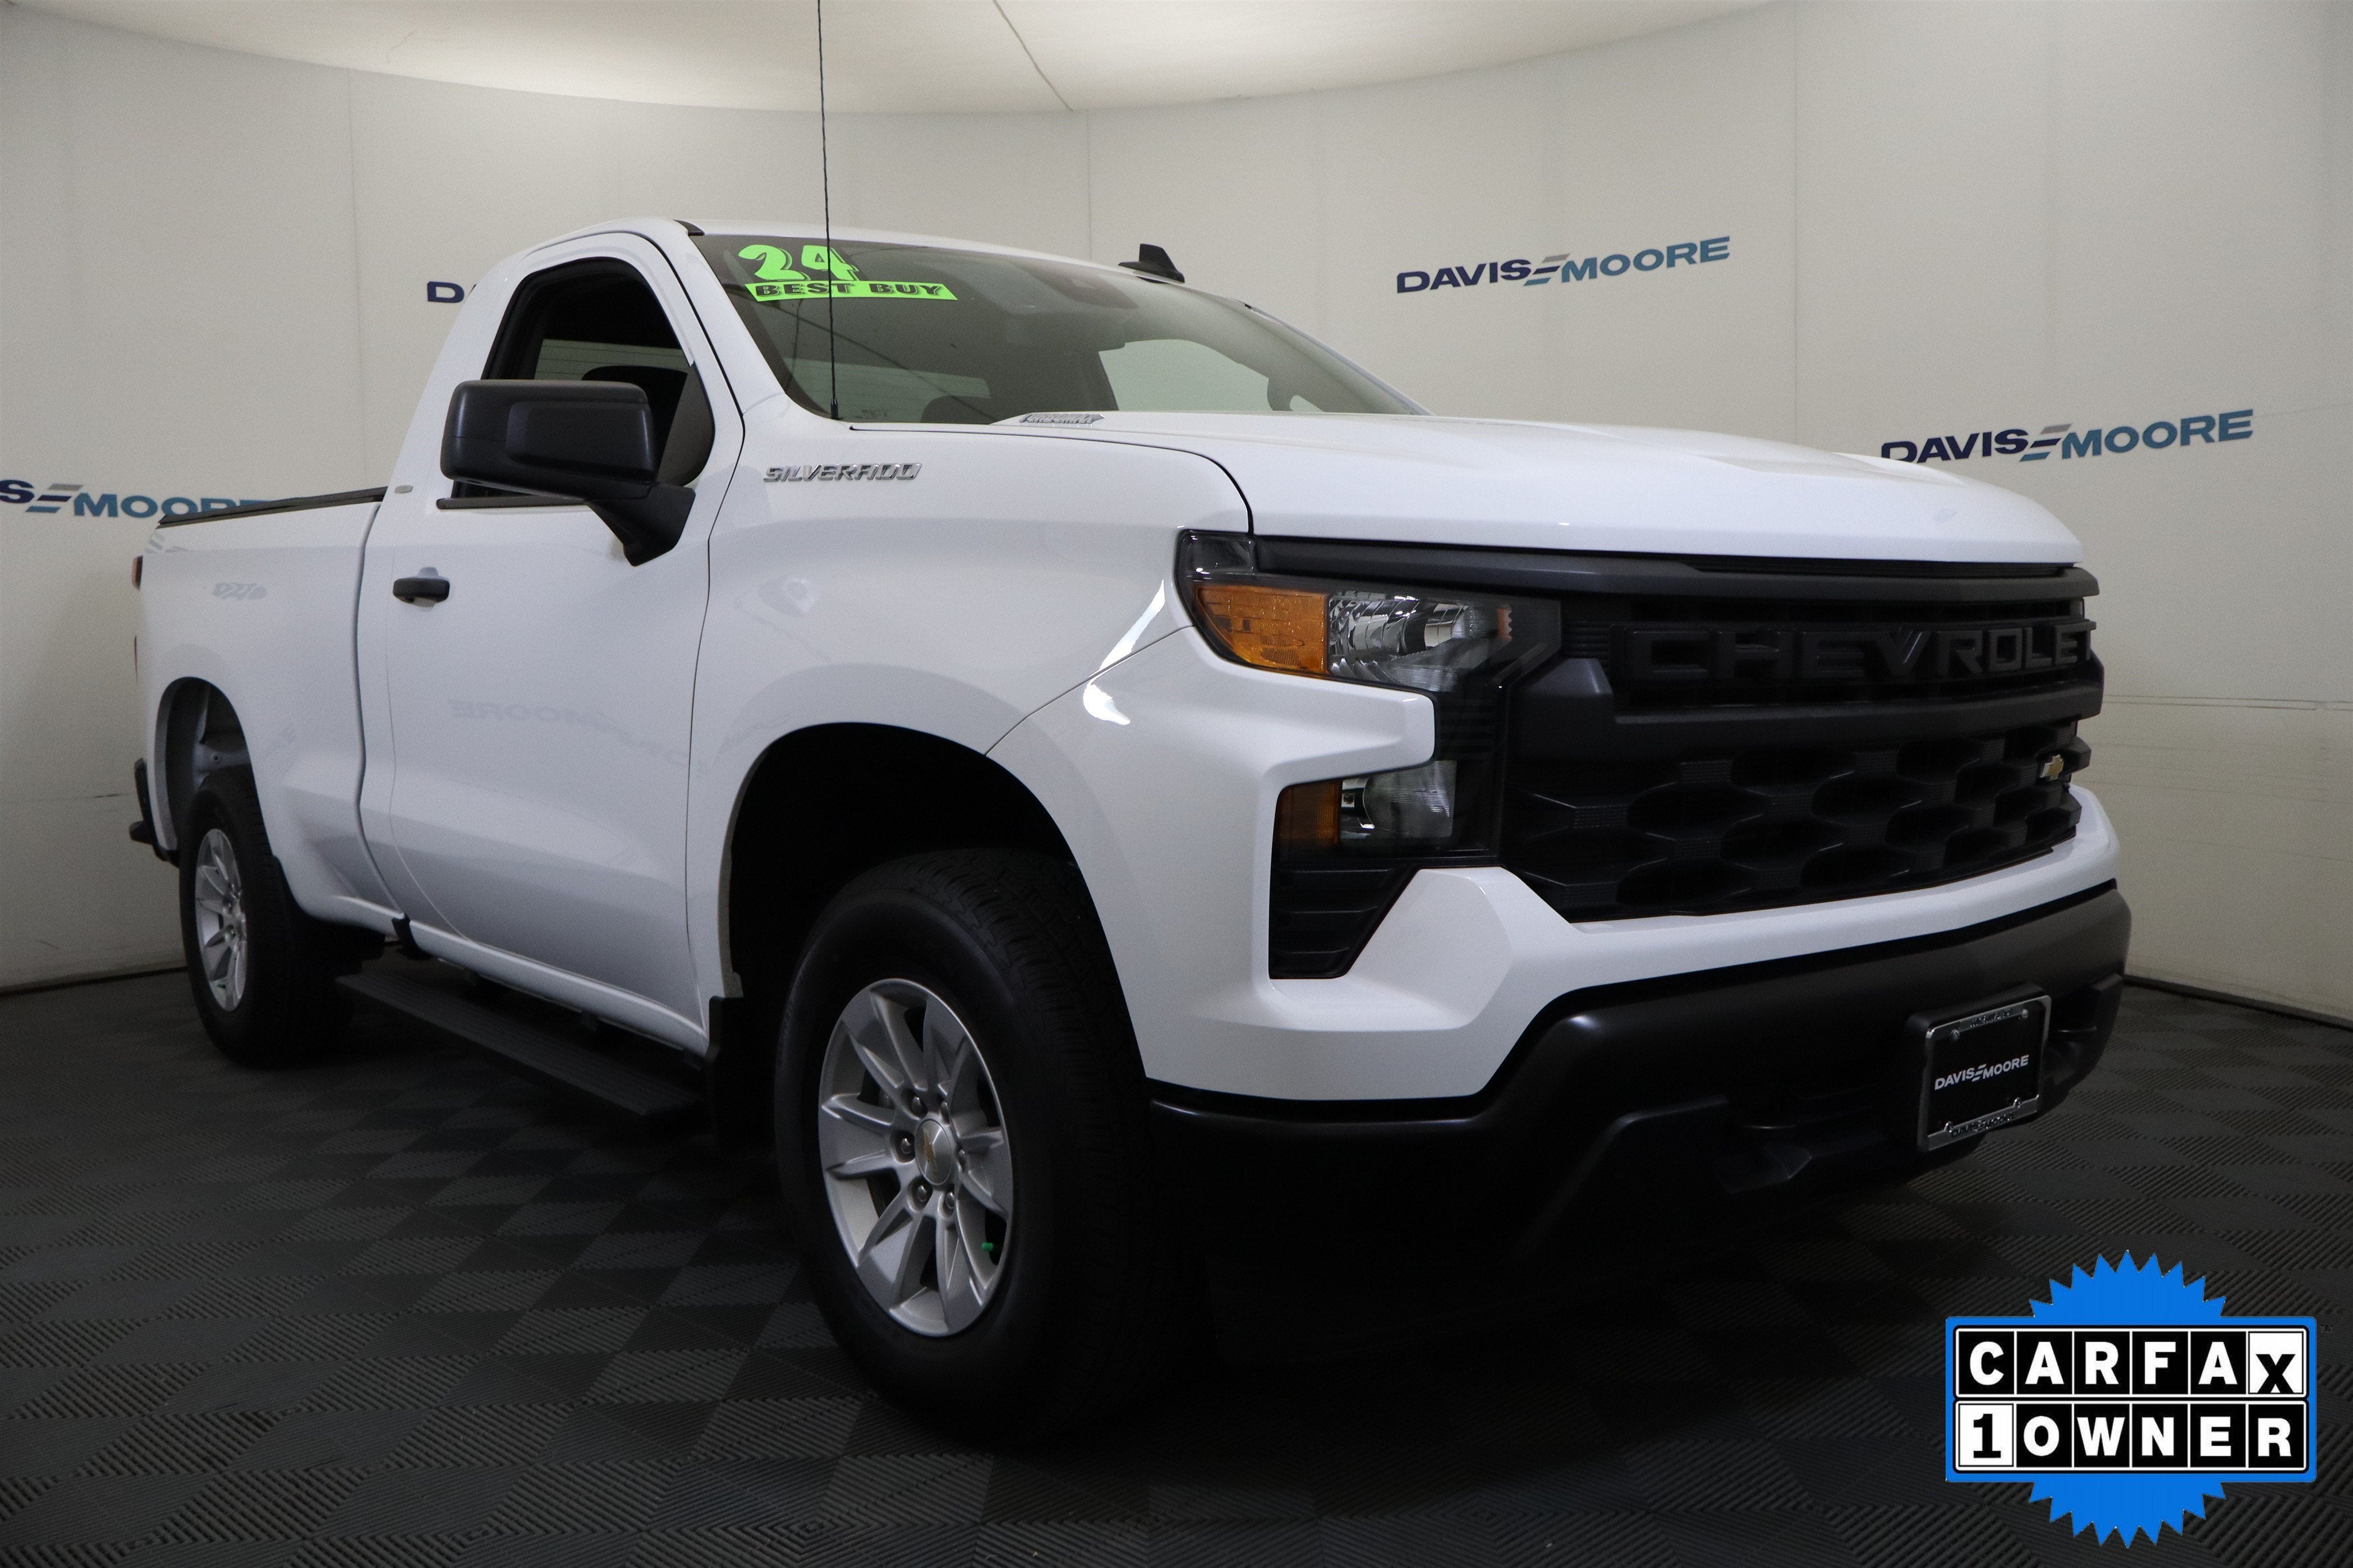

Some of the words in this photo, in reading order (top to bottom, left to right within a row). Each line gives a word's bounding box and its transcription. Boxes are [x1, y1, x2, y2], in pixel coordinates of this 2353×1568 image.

[738, 244, 859, 281] 24
[1397, 258, 1532, 293] DAVIS
[1561, 235, 1730, 283] MOORE
[755, 283, 853, 297] BEST
[869, 283, 940, 296] BUY
[1881, 428, 2028, 464] DAVIS
[2061, 409, 2254, 459] MOORE
[763, 463, 922, 482] SILVERADO
[1934, 1067, 1975, 1090] DAVIS
[1982, 1055, 2029, 1080] MOORE
